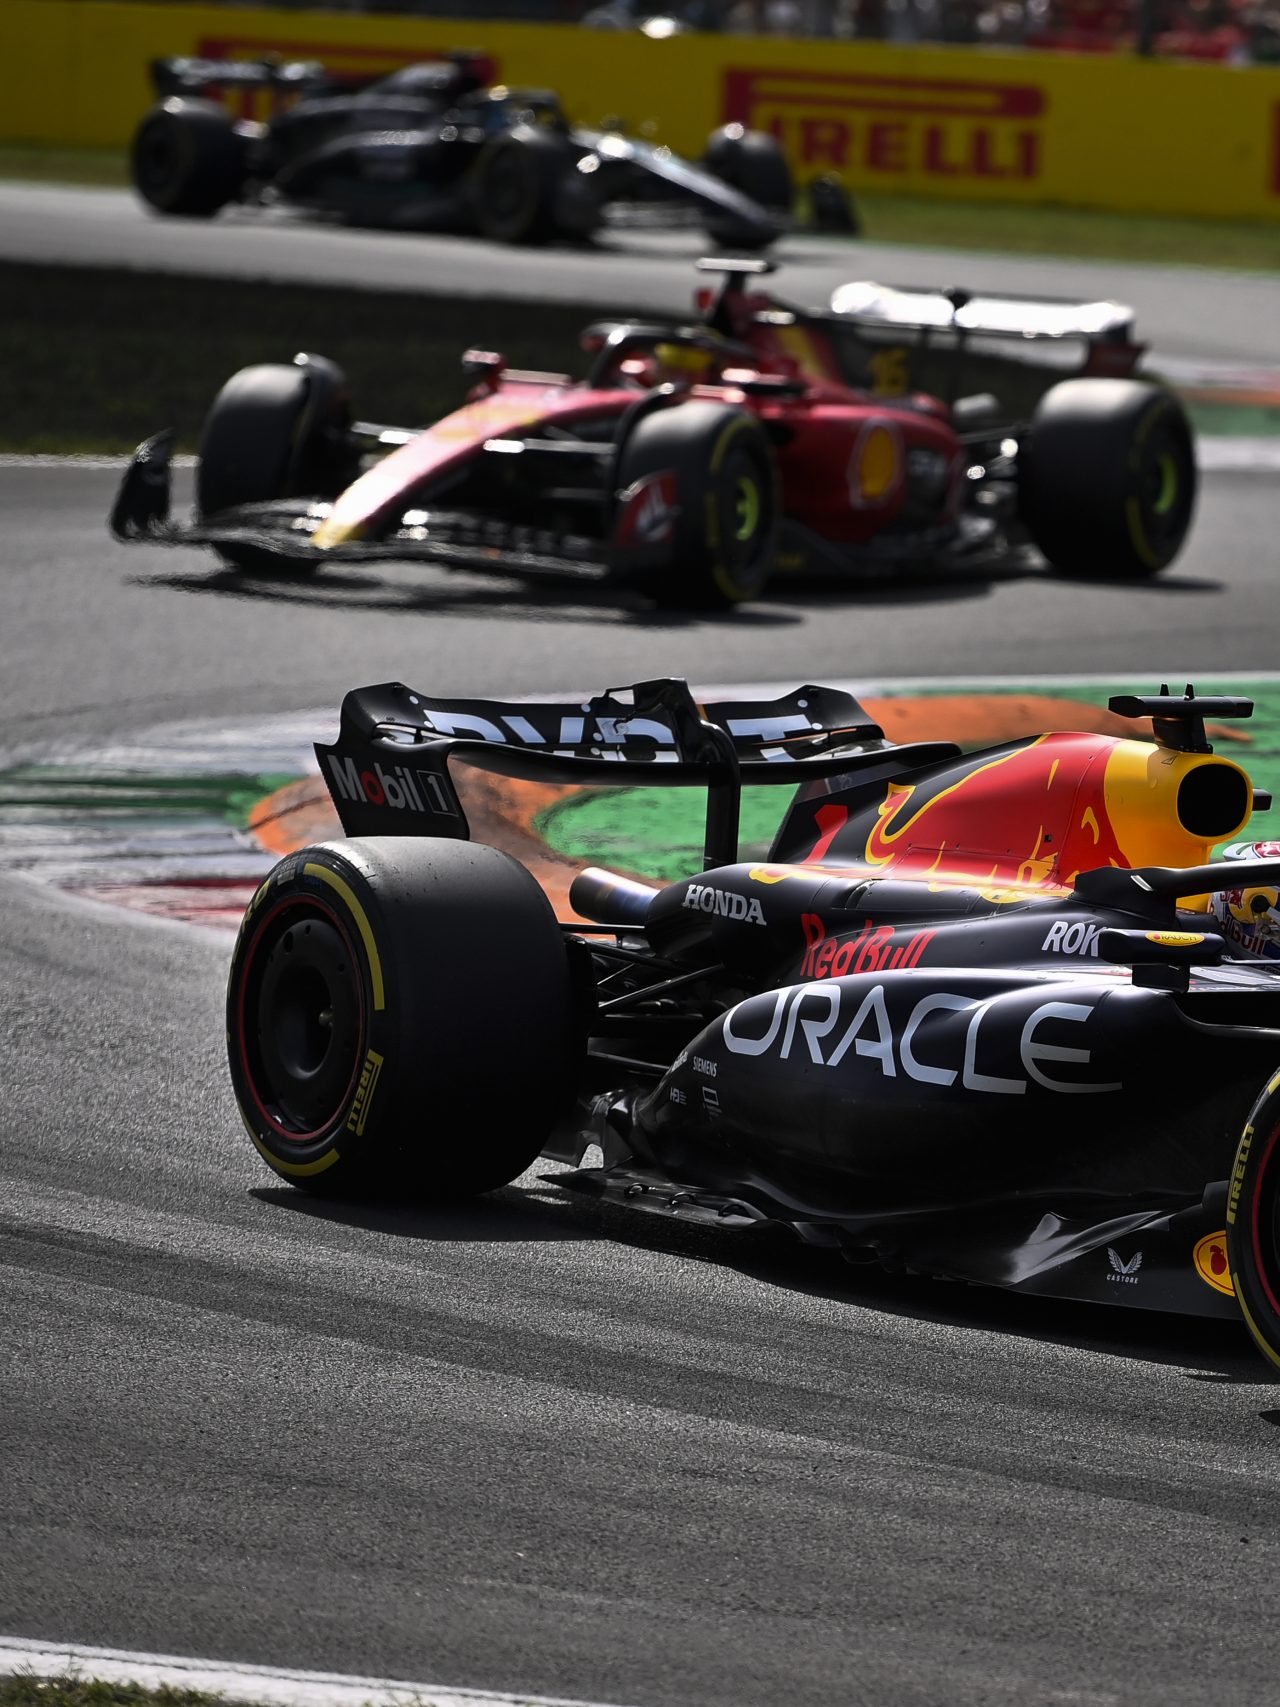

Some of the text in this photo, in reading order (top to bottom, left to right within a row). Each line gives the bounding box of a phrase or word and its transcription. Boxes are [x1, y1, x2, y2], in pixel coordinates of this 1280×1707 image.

[327, 754, 426, 812] Mobil
[682, 884, 767, 926] HONDA
[1041, 921, 1107, 957] ROK
[722, 983, 1123, 1095] ORACLE
[693, 1056, 717, 1077] SIEMENS
[347, 1049, 384, 1136] PIRELLI
[1226, 1122, 1255, 1225] PIRELLI
[1106, 1274, 1139, 1284] CASTORE
